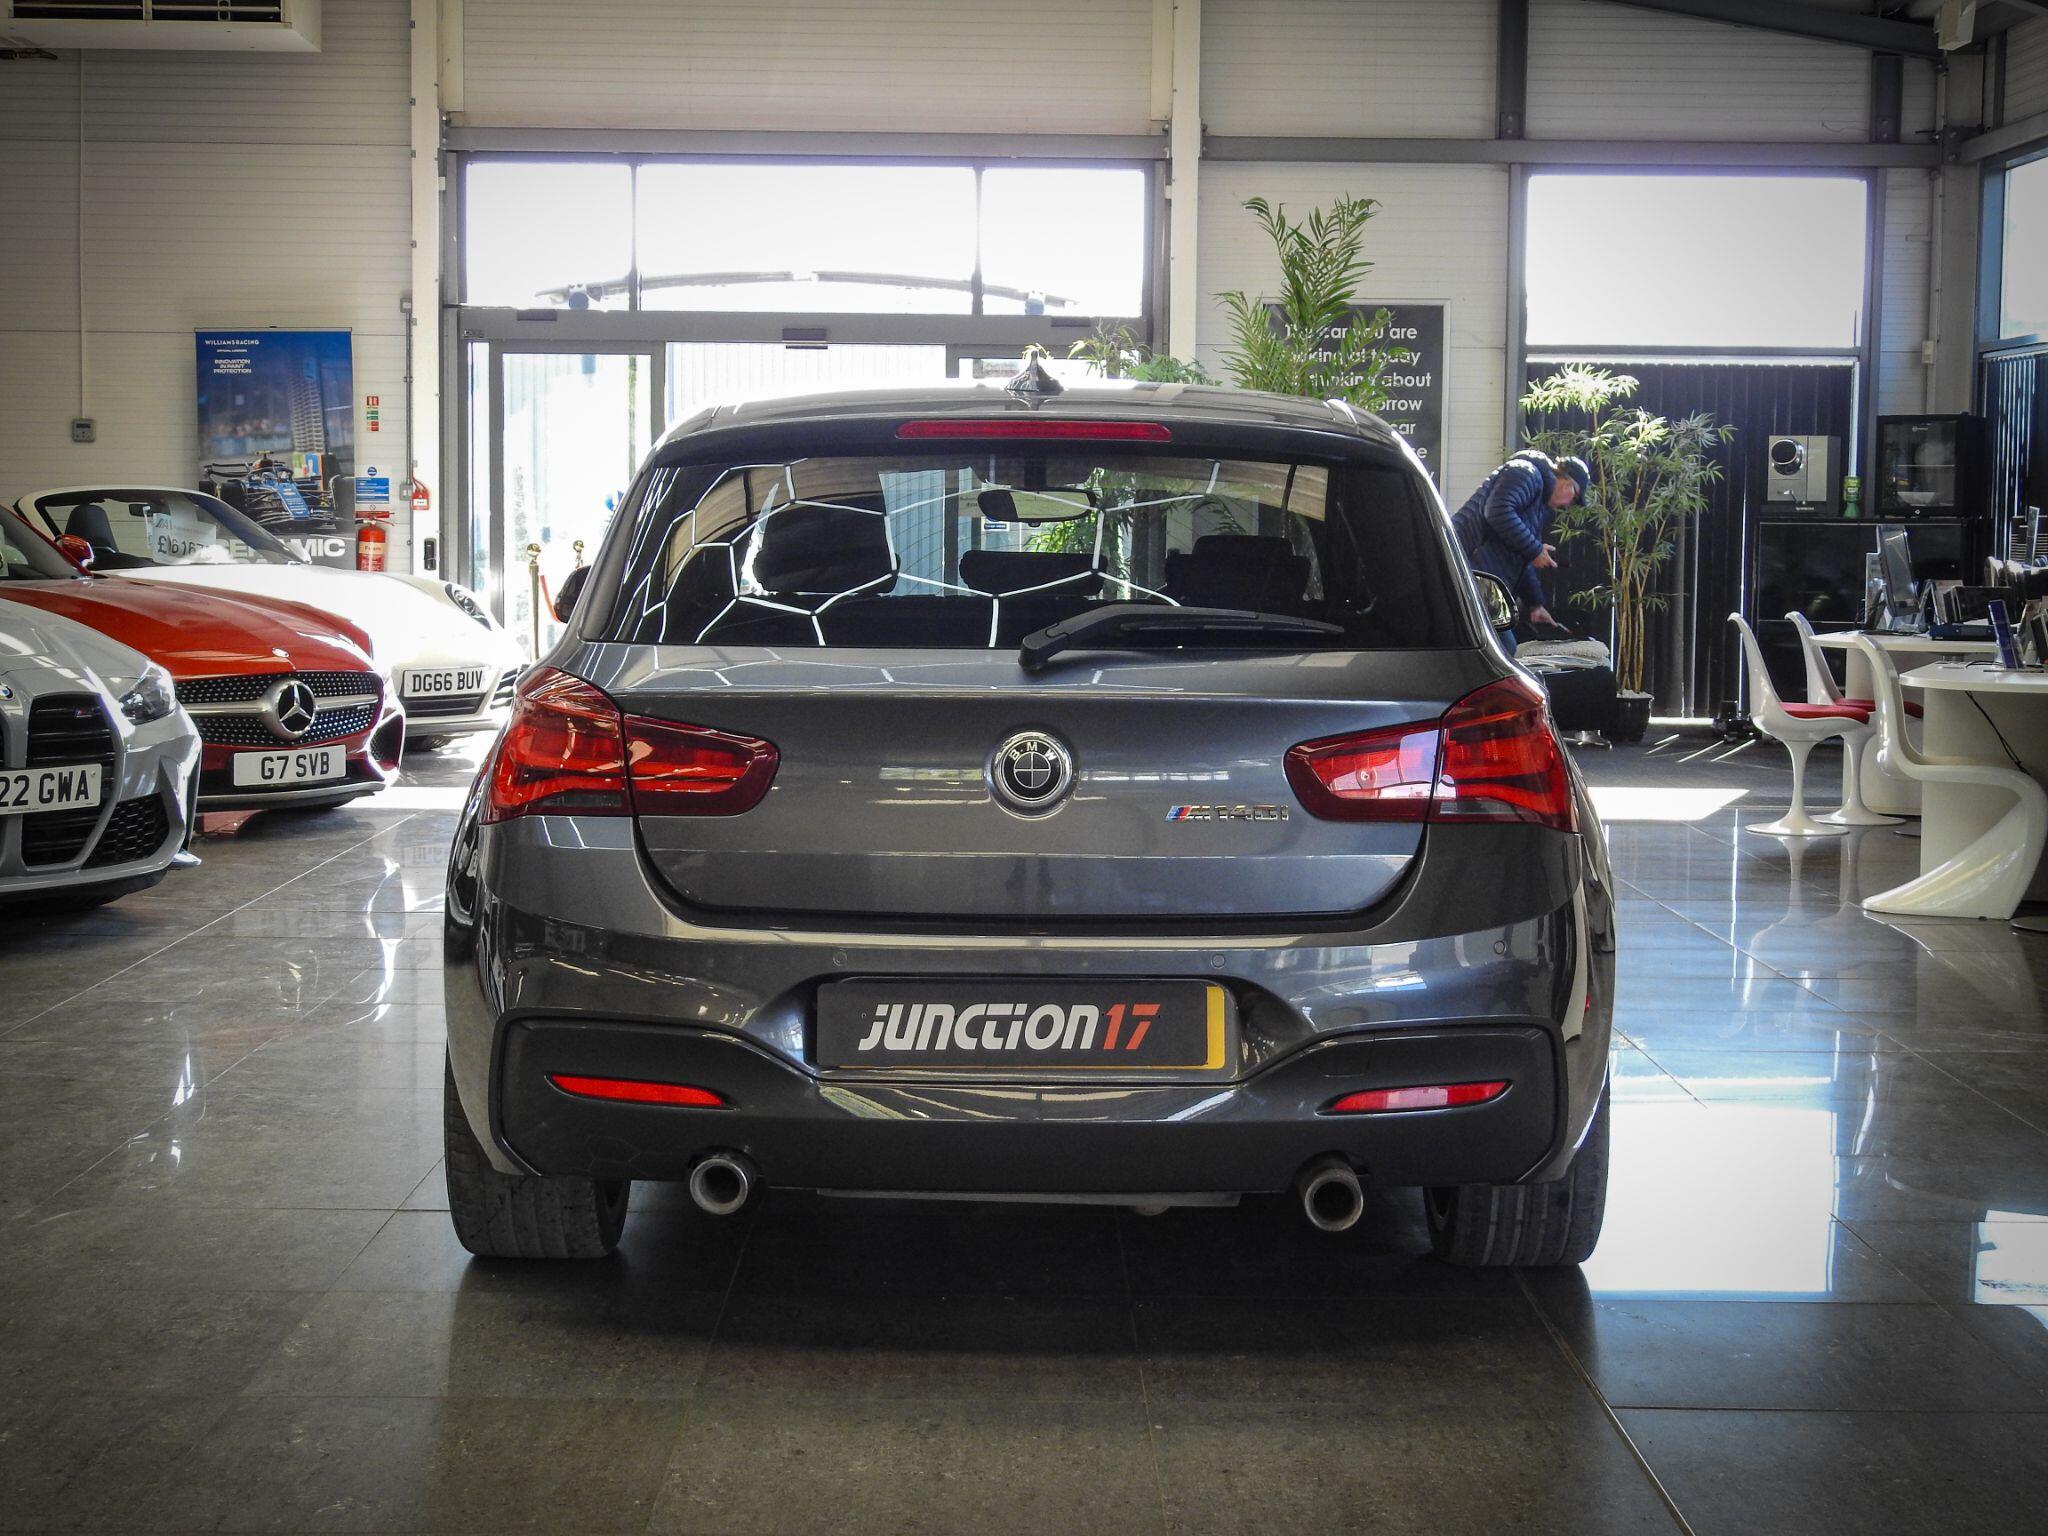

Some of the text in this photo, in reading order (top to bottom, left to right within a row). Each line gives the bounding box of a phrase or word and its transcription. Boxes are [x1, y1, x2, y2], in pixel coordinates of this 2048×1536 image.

[1389, 327, 1417, 339] are
[1381, 372, 1432, 387] about
[412, 670, 483, 692] DG66 BUV
[1009, 741, 1058, 761] BMW
[261, 752, 330, 780] G7 SVB
[39, 769, 90, 804] GWA
